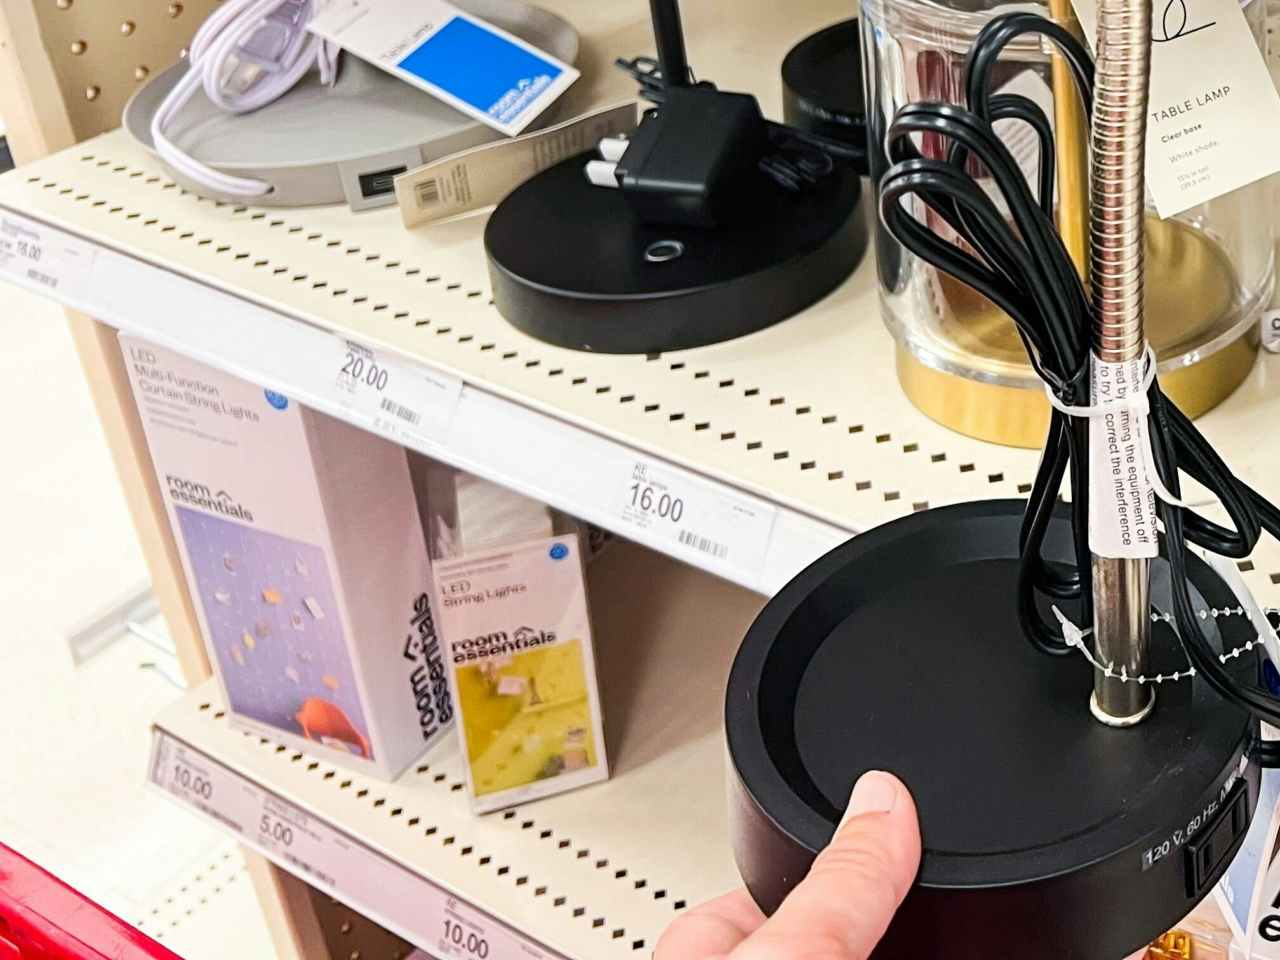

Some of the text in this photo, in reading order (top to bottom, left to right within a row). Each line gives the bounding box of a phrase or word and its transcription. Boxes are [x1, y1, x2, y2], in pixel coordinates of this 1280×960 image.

[1151, 86, 1232, 123] TABLE LAMP
[1161, 123, 1203, 143] Clear base
[130, 345, 156, 364] LED
[134, 363, 220, 397] Multi-Function
[341, 352, 388, 391] 20.00
[1100, 366, 1109, 377] to
[138, 379, 183, 401] Curtain
[184, 391, 222, 414] String
[222, 402, 260, 422] Lights
[1101, 381, 1112, 396] try
[1116, 386, 1127, 400] by
[1104, 413, 1120, 454] correct
[1110, 456, 1121, 475] the
[1125, 443, 1136, 464] the
[166, 475, 210, 497] room
[631, 483, 684, 522] 16.00
[1127, 466, 1145, 526] equipment
[170, 489, 254, 522] essentials
[1114, 480, 1132, 546] interference
[1137, 528, 1150, 543] off
[441, 581, 471, 596] LED
[444, 584, 528, 608] String Lights
[451, 630, 508, 653] room
[453, 630, 557, 664] essentials
[410, 591, 455, 726] essentials
[409, 664, 439, 742] room
[173, 765, 212, 800] 10.00
[259, 814, 294, 847] 5.00
[1145, 841, 1170, 865] 120
[1187, 816, 1201, 836] 60
[443, 919, 489, 960] 10.00
